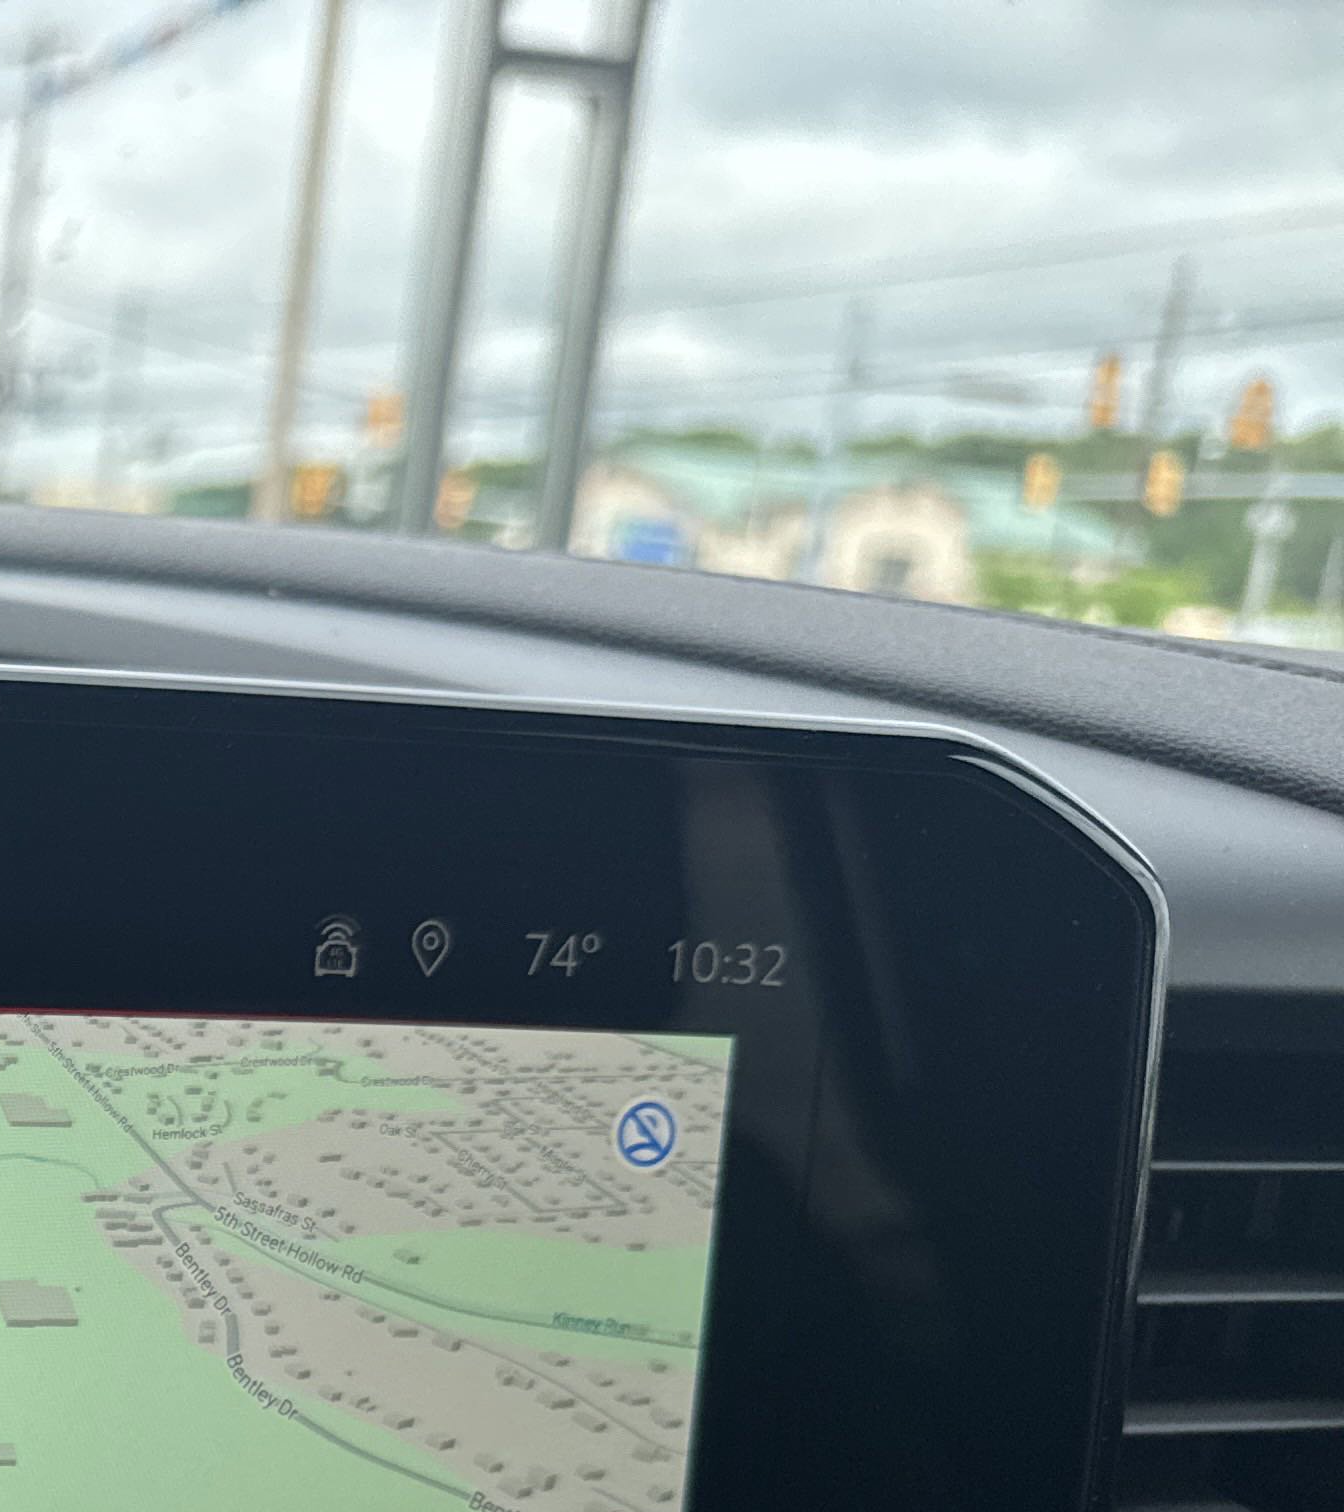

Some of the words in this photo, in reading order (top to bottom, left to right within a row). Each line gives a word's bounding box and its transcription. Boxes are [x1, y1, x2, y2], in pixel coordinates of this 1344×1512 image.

[665, 939, 787, 988] 10:32
[62, 1057, 91, 1090] Street
[87, 1083, 121, 1119] Hollow
[118, 1115, 134, 1134] Rd
[152, 1127, 206, 1141] Hemlock
[208, 1123, 224, 1136] St
[212, 1205, 240, 1232] 5th
[239, 1213, 286, 1256] Street
[286, 1241, 339, 1278] Hollow
[340, 1262, 365, 1285] Rd
[232, 1191, 300, 1228] Sassafras
[301, 1215, 318, 1232] St
[174, 1241, 220, 1304] Bentley
[213, 1289, 234, 1317] Dr
[226, 1353, 279, 1410] Bentley
[275, 1397, 300, 1420] Dr
